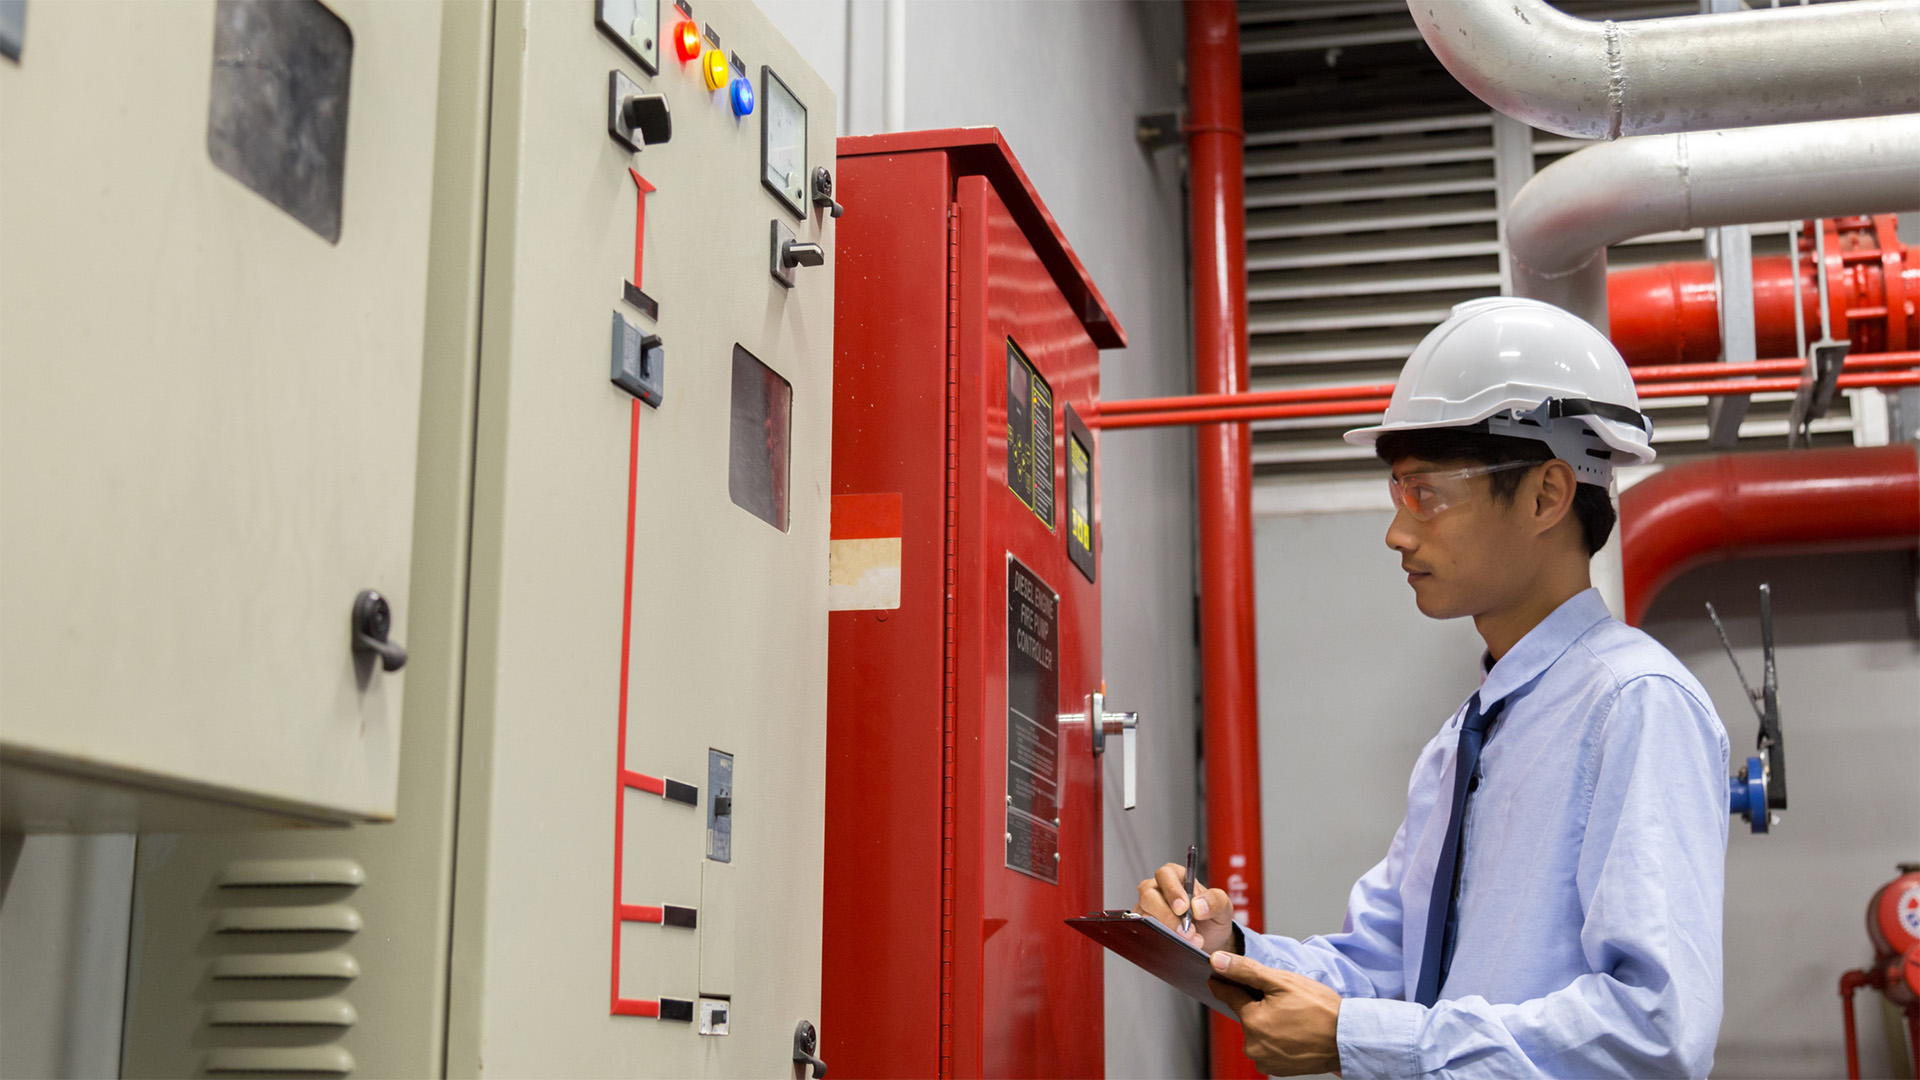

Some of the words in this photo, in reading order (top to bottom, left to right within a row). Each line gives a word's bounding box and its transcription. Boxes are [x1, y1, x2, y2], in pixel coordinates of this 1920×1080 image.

[1014, 570, 1034, 604] DIESEL
[1034, 586, 1054, 620] ENGINE
[1020, 603, 1033, 630] FIRE
[1033, 614, 1049, 641] PUMP
[1016, 627, 1053, 671] CONTROLLER
